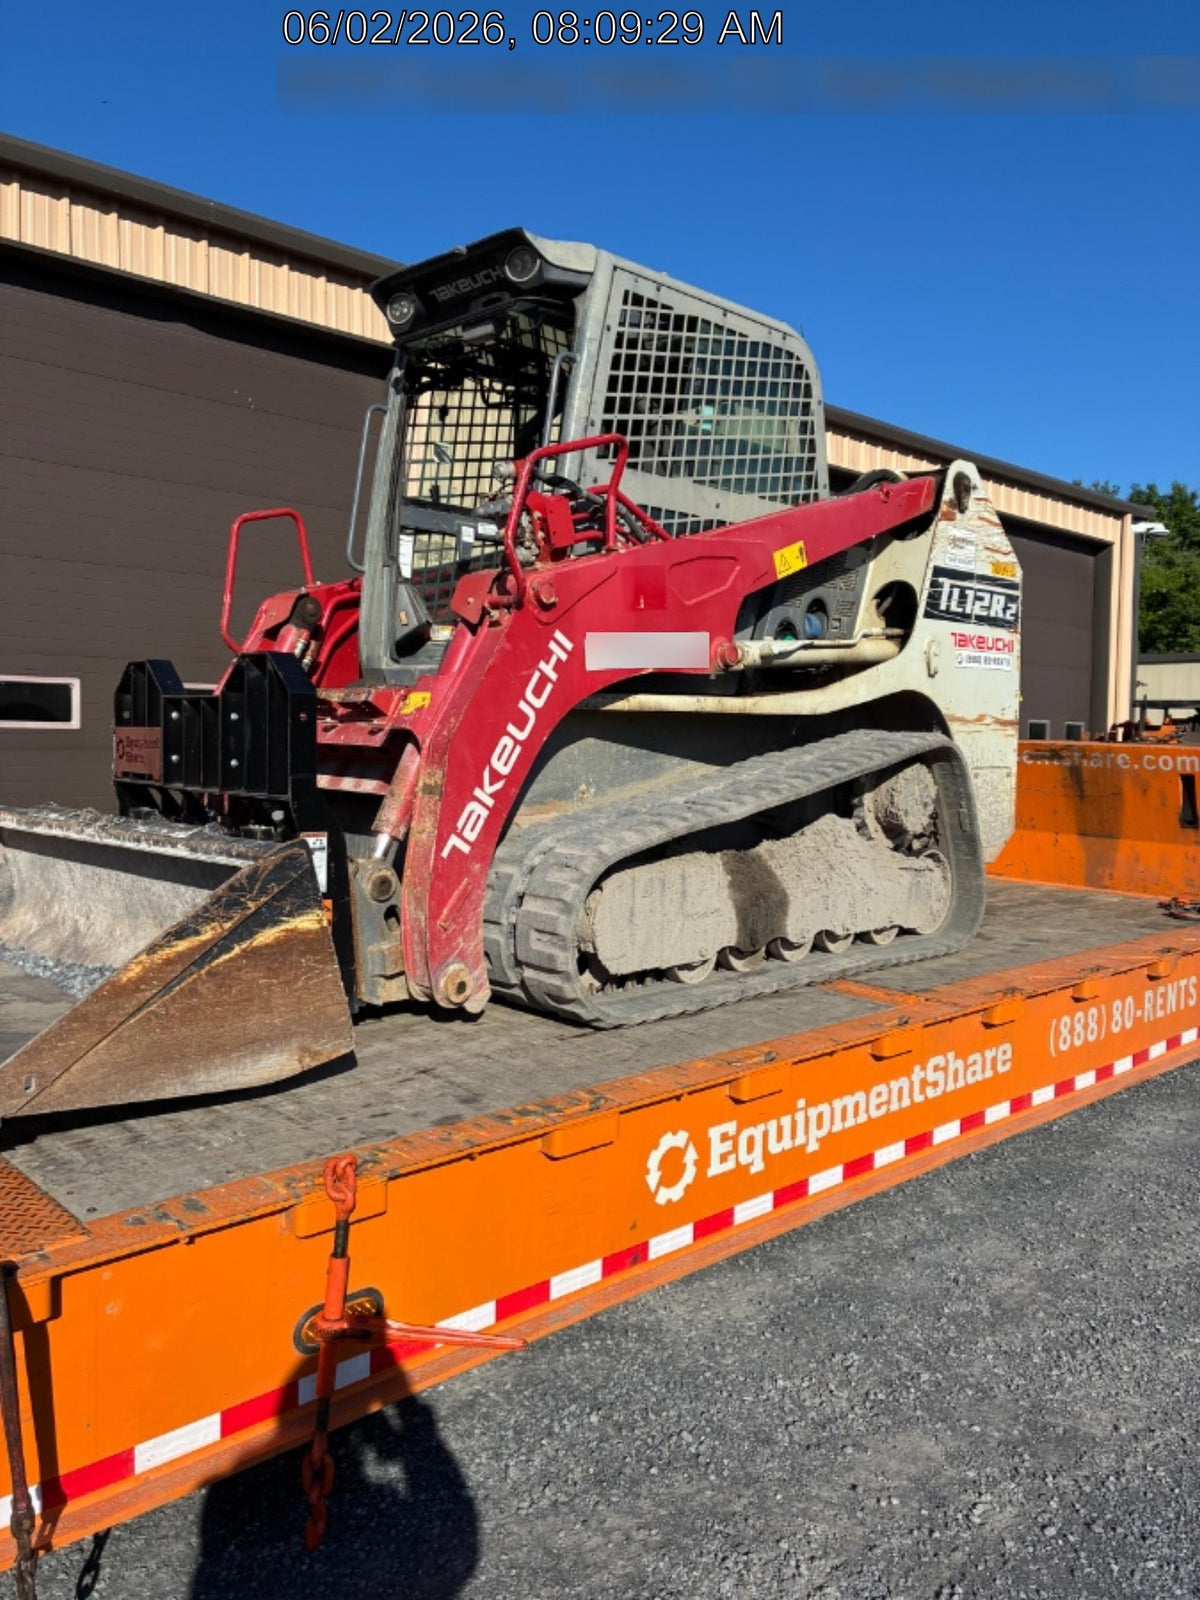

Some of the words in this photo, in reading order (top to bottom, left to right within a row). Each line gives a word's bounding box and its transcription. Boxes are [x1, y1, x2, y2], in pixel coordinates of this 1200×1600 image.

[1050, 1004, 1107, 1058] (888)
[1110, 975, 1198, 1034] 80-RENTS
[706, 1041, 1013, 1178] EquipmentShare
